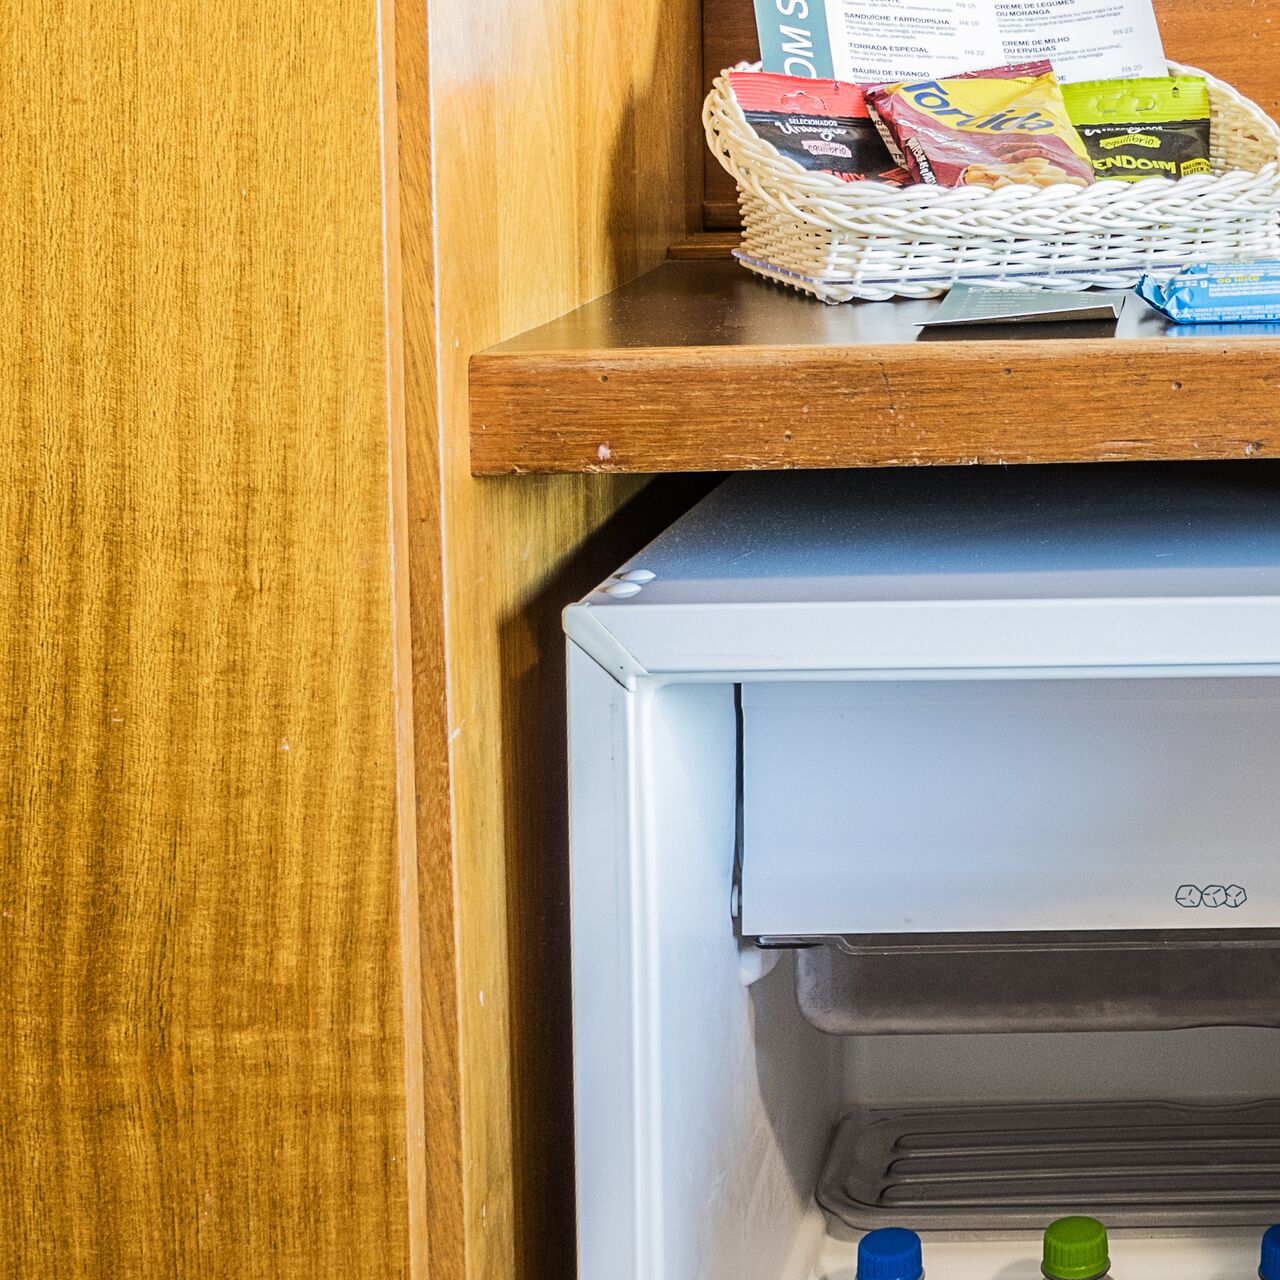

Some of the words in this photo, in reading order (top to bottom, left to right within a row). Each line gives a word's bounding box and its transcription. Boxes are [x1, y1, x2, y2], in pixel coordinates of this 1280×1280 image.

[1036, 0, 1075, 8] LEGUMES
[1009, 9, 1051, 17] MORANGA
[893, 16, 950, 25] FARROUPILHA
[1044, 36, 1070, 45] MILHO
[849, 42, 888, 51] TORRADA
[888, 45, 929, 53] ESPECIAL
[1016, 45, 1057, 54] ERVILHAS
[852, 67, 881, 75] BAURU
[894, 71, 930, 79] FRANGO
[788, 118, 838, 127] SELECIONADOS
[1092, 155, 1177, 174] ENDOIM
